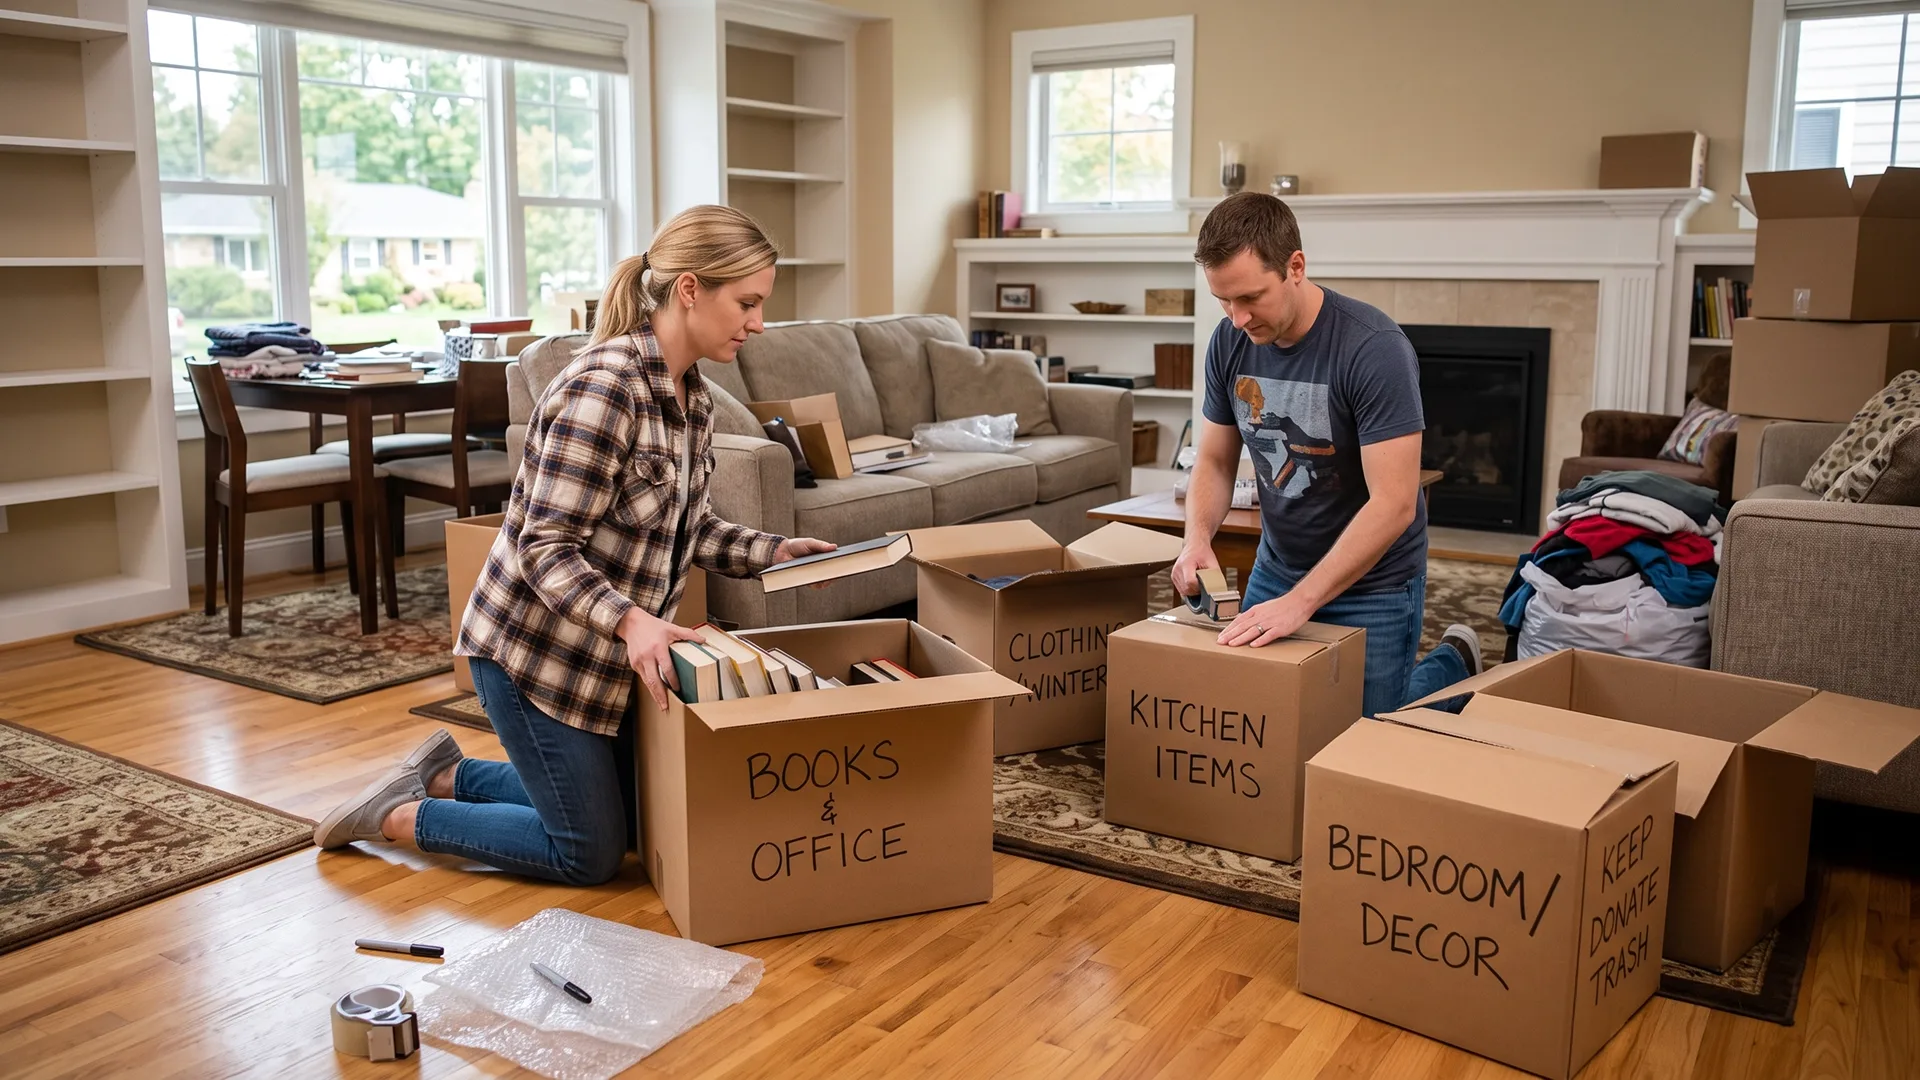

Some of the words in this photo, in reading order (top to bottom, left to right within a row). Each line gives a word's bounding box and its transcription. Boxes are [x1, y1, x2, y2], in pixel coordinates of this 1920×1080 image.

[1009, 622, 1125, 662] CLOTHIN
[1131, 689, 1266, 749] KITCHEN
[746, 740, 900, 800] BOOKS
[1156, 746, 1261, 798] ITEMS
[820, 792, 838, 825] &
[751, 823, 908, 882] OFFICE
[1328, 824, 1562, 937] BEDROOM/
[1601, 814, 1654, 894] KEEP
[1589, 866, 1660, 958] DONATE
[1361, 902, 1509, 991] DECOR
[1589, 925, 1650, 1006] TRASH
